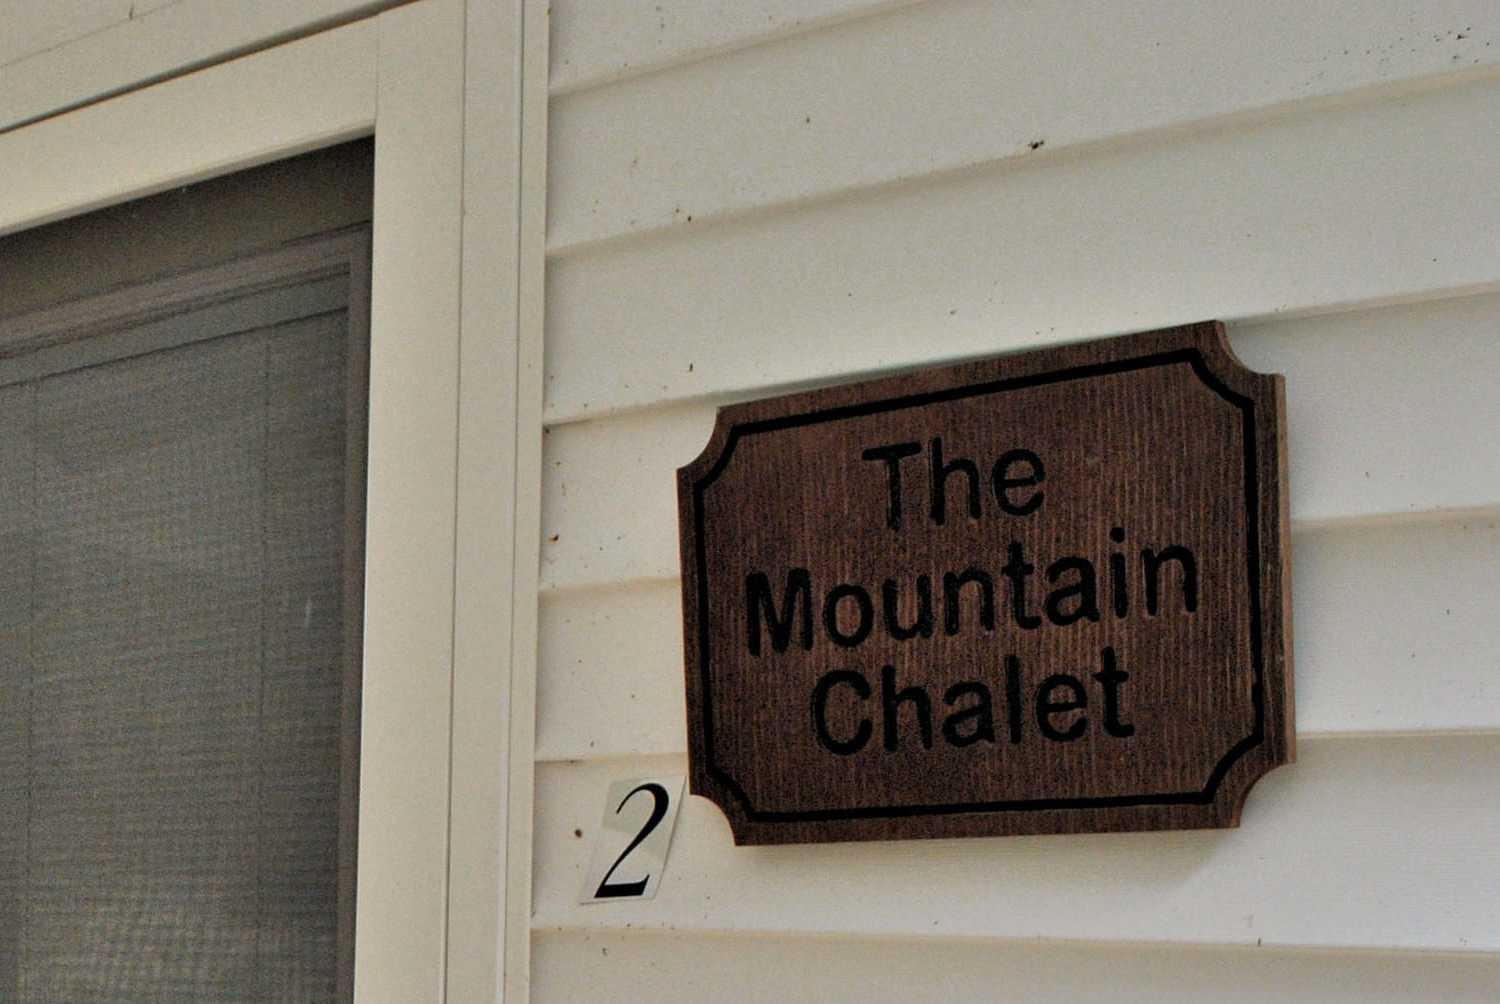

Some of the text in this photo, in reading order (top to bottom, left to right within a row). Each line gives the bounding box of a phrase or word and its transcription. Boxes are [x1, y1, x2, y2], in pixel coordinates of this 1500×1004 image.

[864, 439, 1047, 528] The
[746, 527, 1198, 656] Mountain
[813, 647, 1135, 757] Chalet
[594, 782, 670, 899] 2
